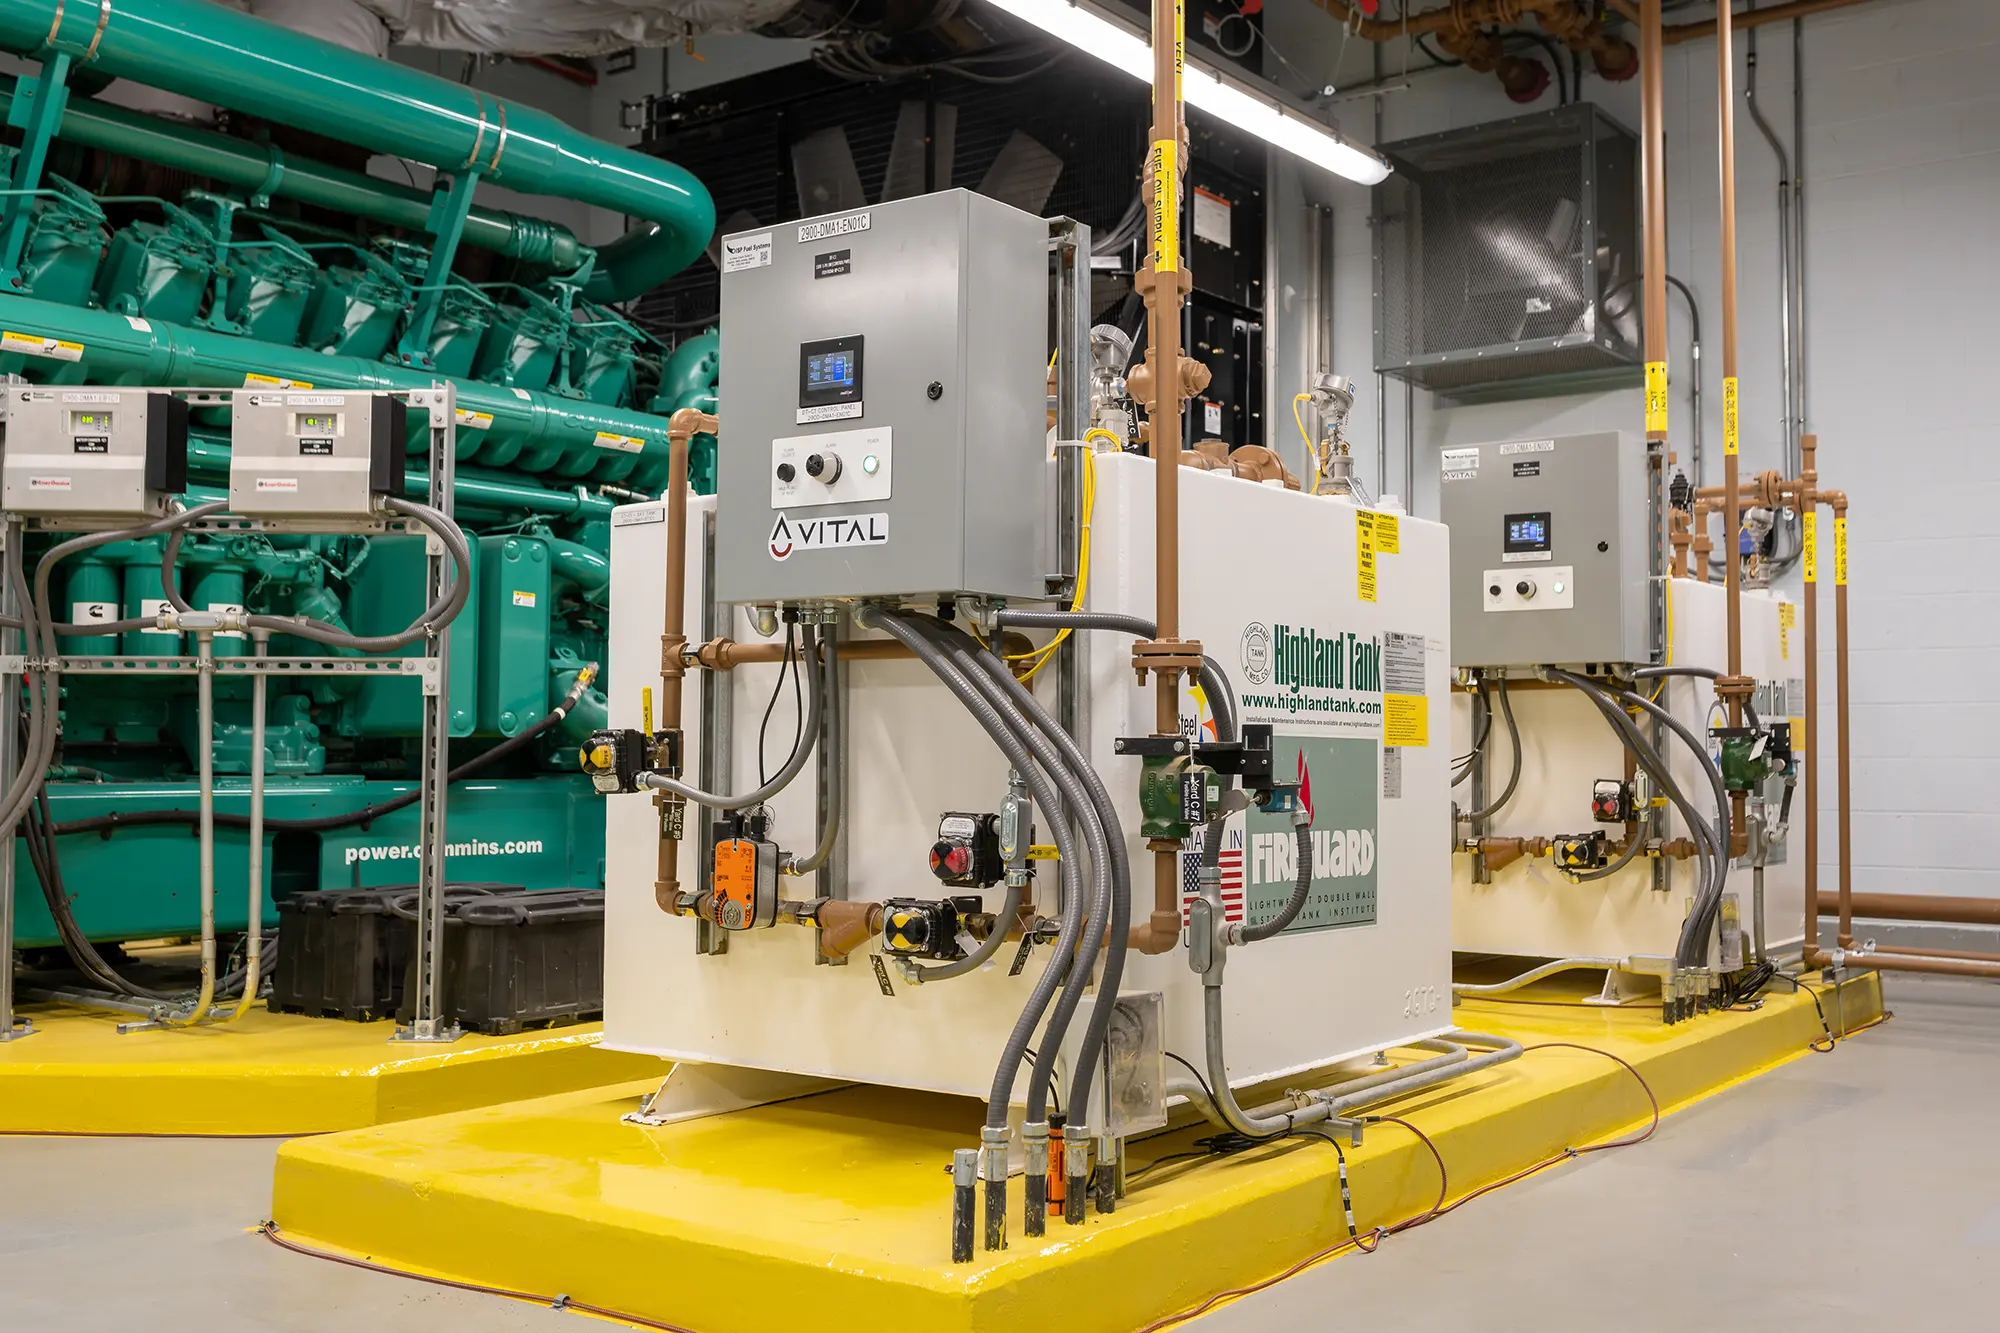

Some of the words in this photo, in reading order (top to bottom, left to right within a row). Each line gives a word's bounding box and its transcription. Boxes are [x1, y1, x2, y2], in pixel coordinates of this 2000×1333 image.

[801, 215, 866, 240] 2900-DMA1-EN01C
[753, 243, 770, 251] Systems
[818, 406, 838, 414] CONTROL
[798, 518, 886, 544] VITAL
[1245, 626, 1269, 642] HIGHLAND
[1251, 648, 1264, 657] TANK
[1274, 624, 1344, 694] Highland
[1347, 633, 1381, 692] Tank
[1242, 693, 1381, 714] www.highlandtank.com
[1178, 714, 1197, 736] teel
[674, 808, 682, 822] Yard
[1191, 810, 1199, 821] #7
[1230, 830, 1242, 849] IN
[1318, 893, 1350, 903] DOUBLE
[1355, 890, 1375, 900] WALL
[1330, 905, 1375, 916] INSTITUTE
